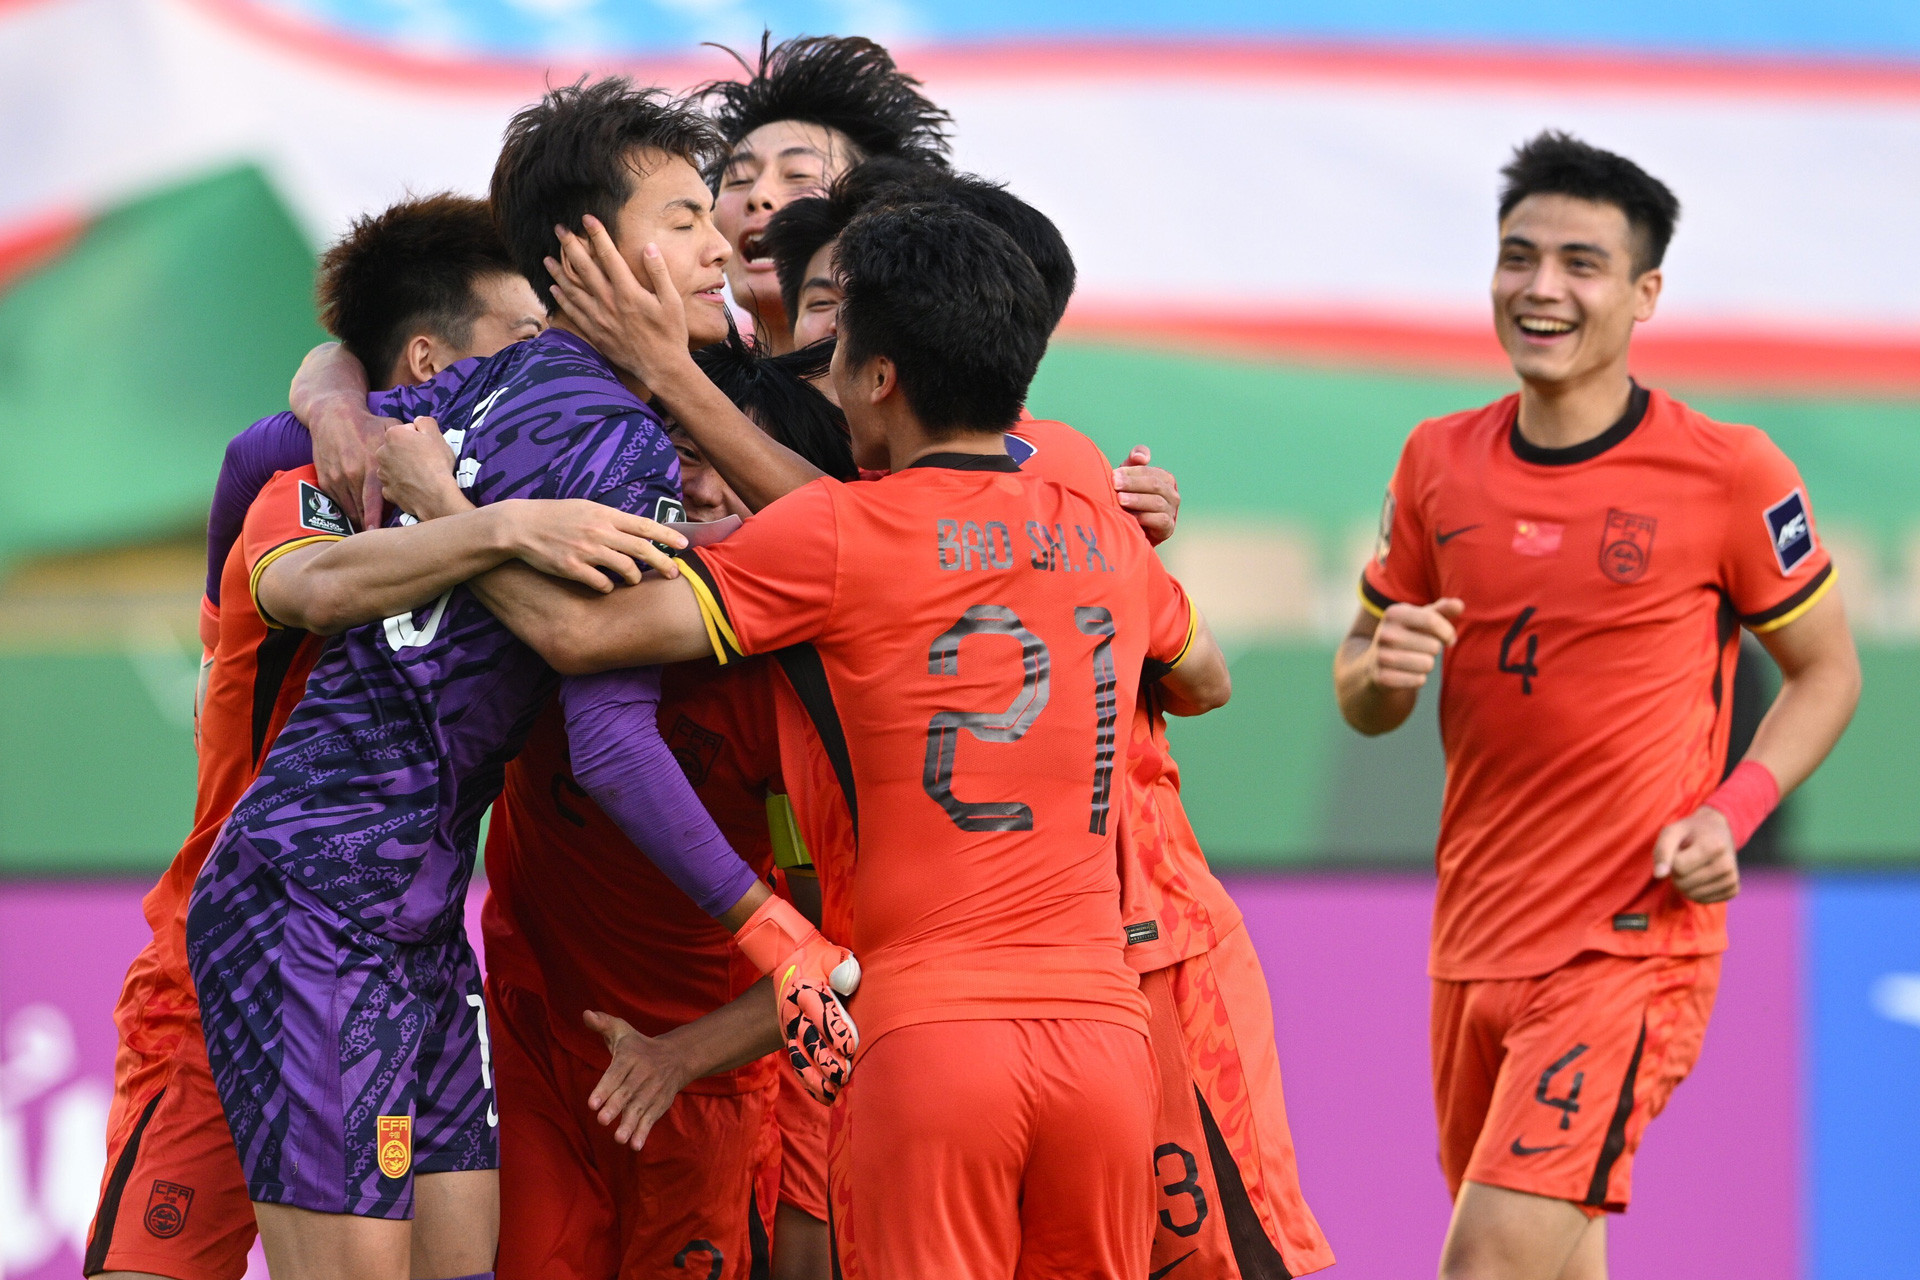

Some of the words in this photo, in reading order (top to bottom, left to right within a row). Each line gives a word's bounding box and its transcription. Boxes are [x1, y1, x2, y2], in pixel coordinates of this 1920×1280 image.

[937, 518, 1013, 571] BAO
[1498, 606, 1538, 695] 4
[922, 604, 1117, 836] 21
[1535, 1044, 1591, 1130] 4
[380, 1120, 408, 1131] CFA
[156, 1183, 190, 1200] CFA
